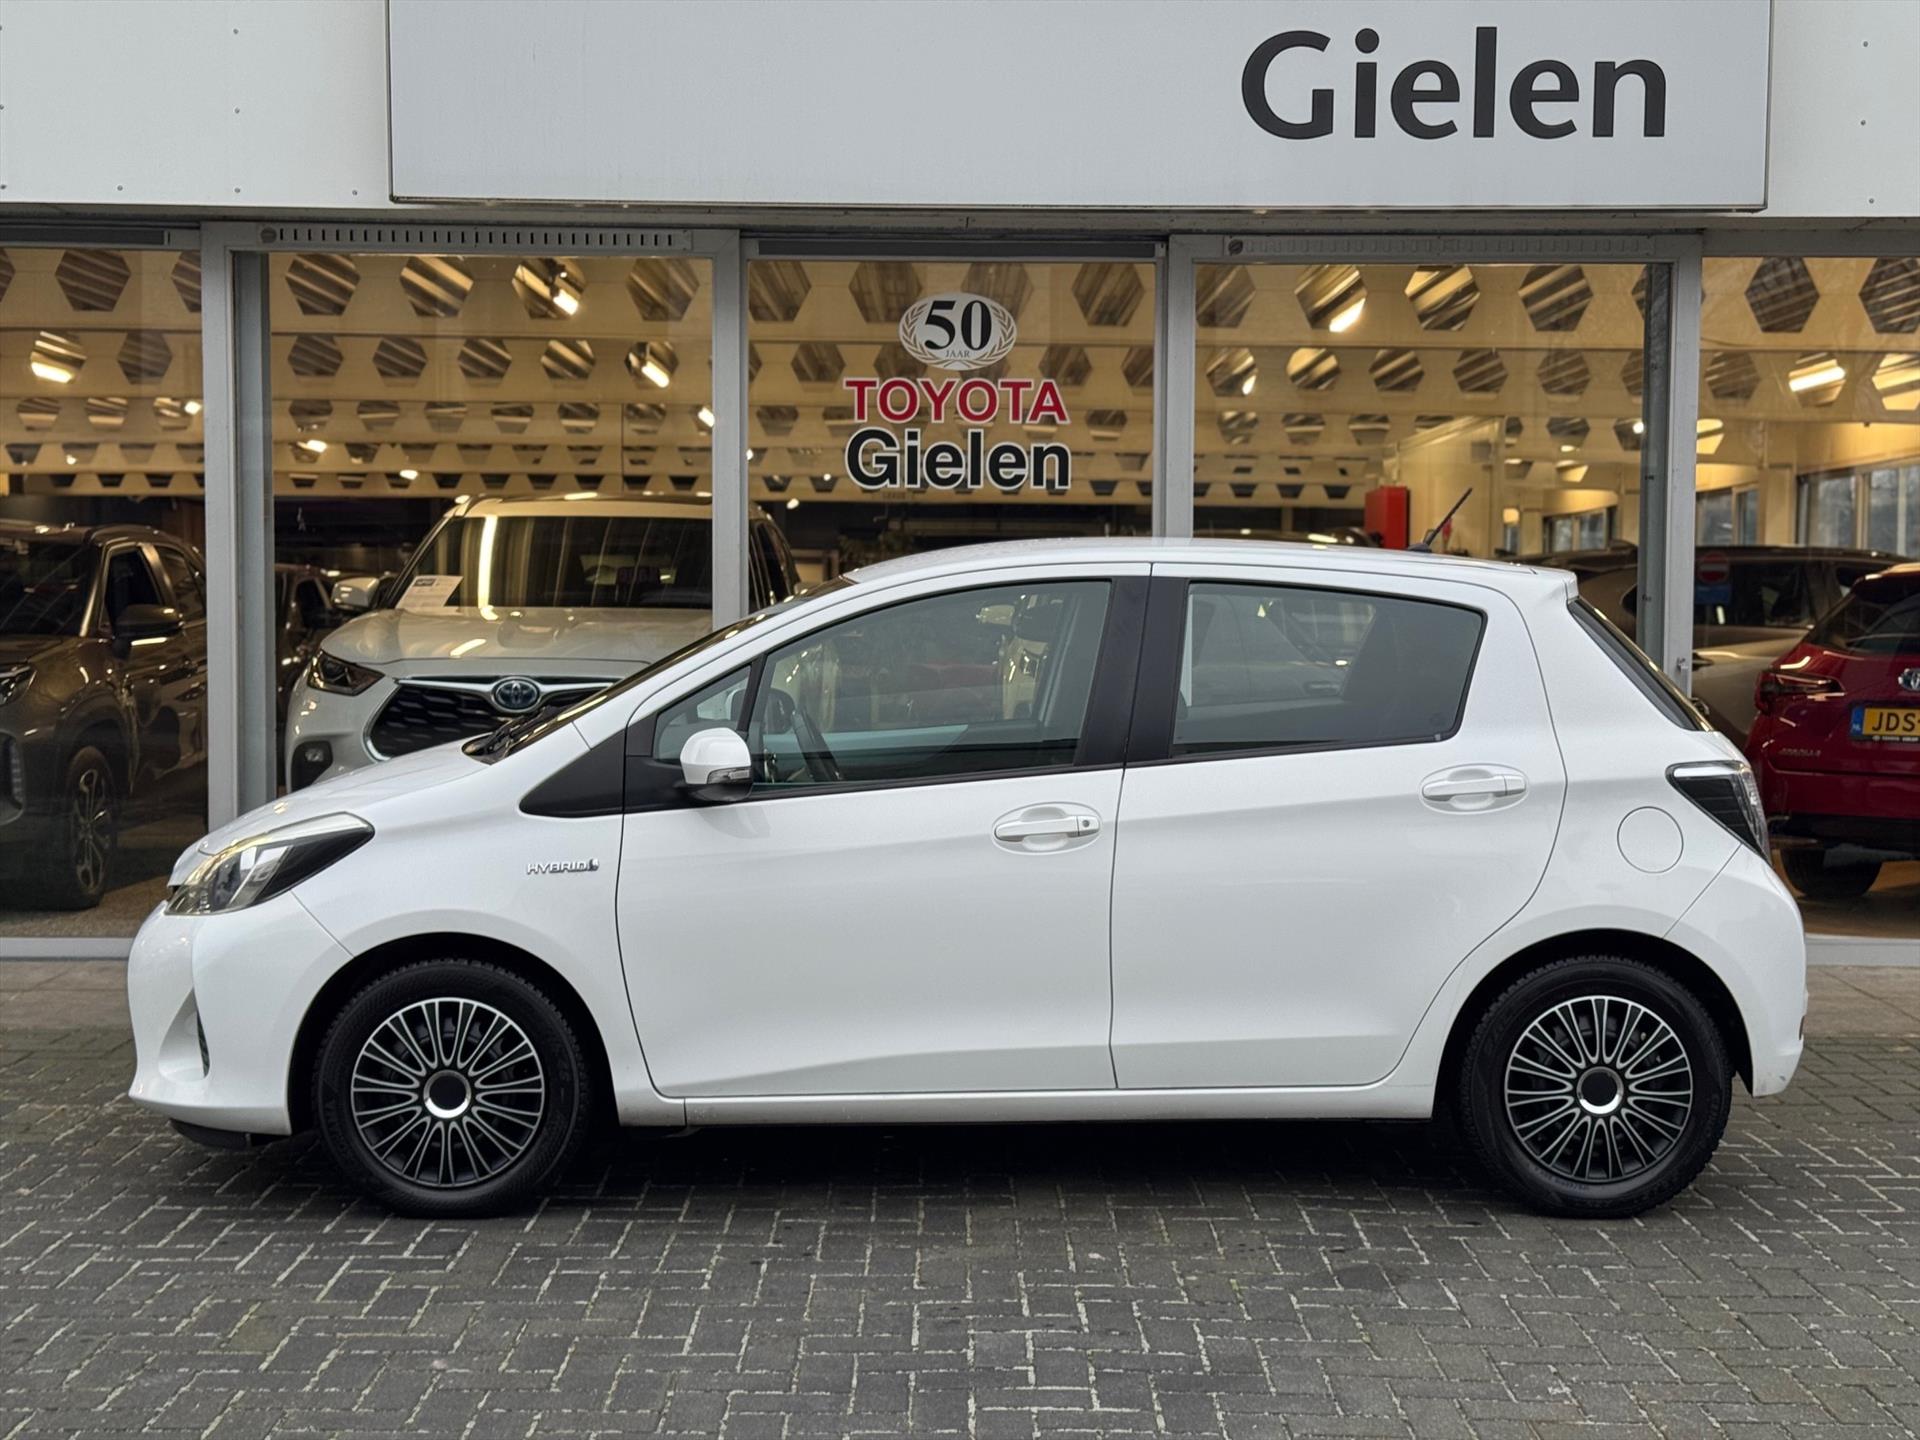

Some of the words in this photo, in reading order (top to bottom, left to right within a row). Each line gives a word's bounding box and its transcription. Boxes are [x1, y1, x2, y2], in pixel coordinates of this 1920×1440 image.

[1241, 26, 1667, 140] Gielen
[924, 299, 993, 351] 50
[945, 349, 971, 359] JAAR
[843, 378, 1070, 424] TOYOTA
[845, 427, 1071, 490] Gielen
[526, 860, 588, 874] HYBRID
